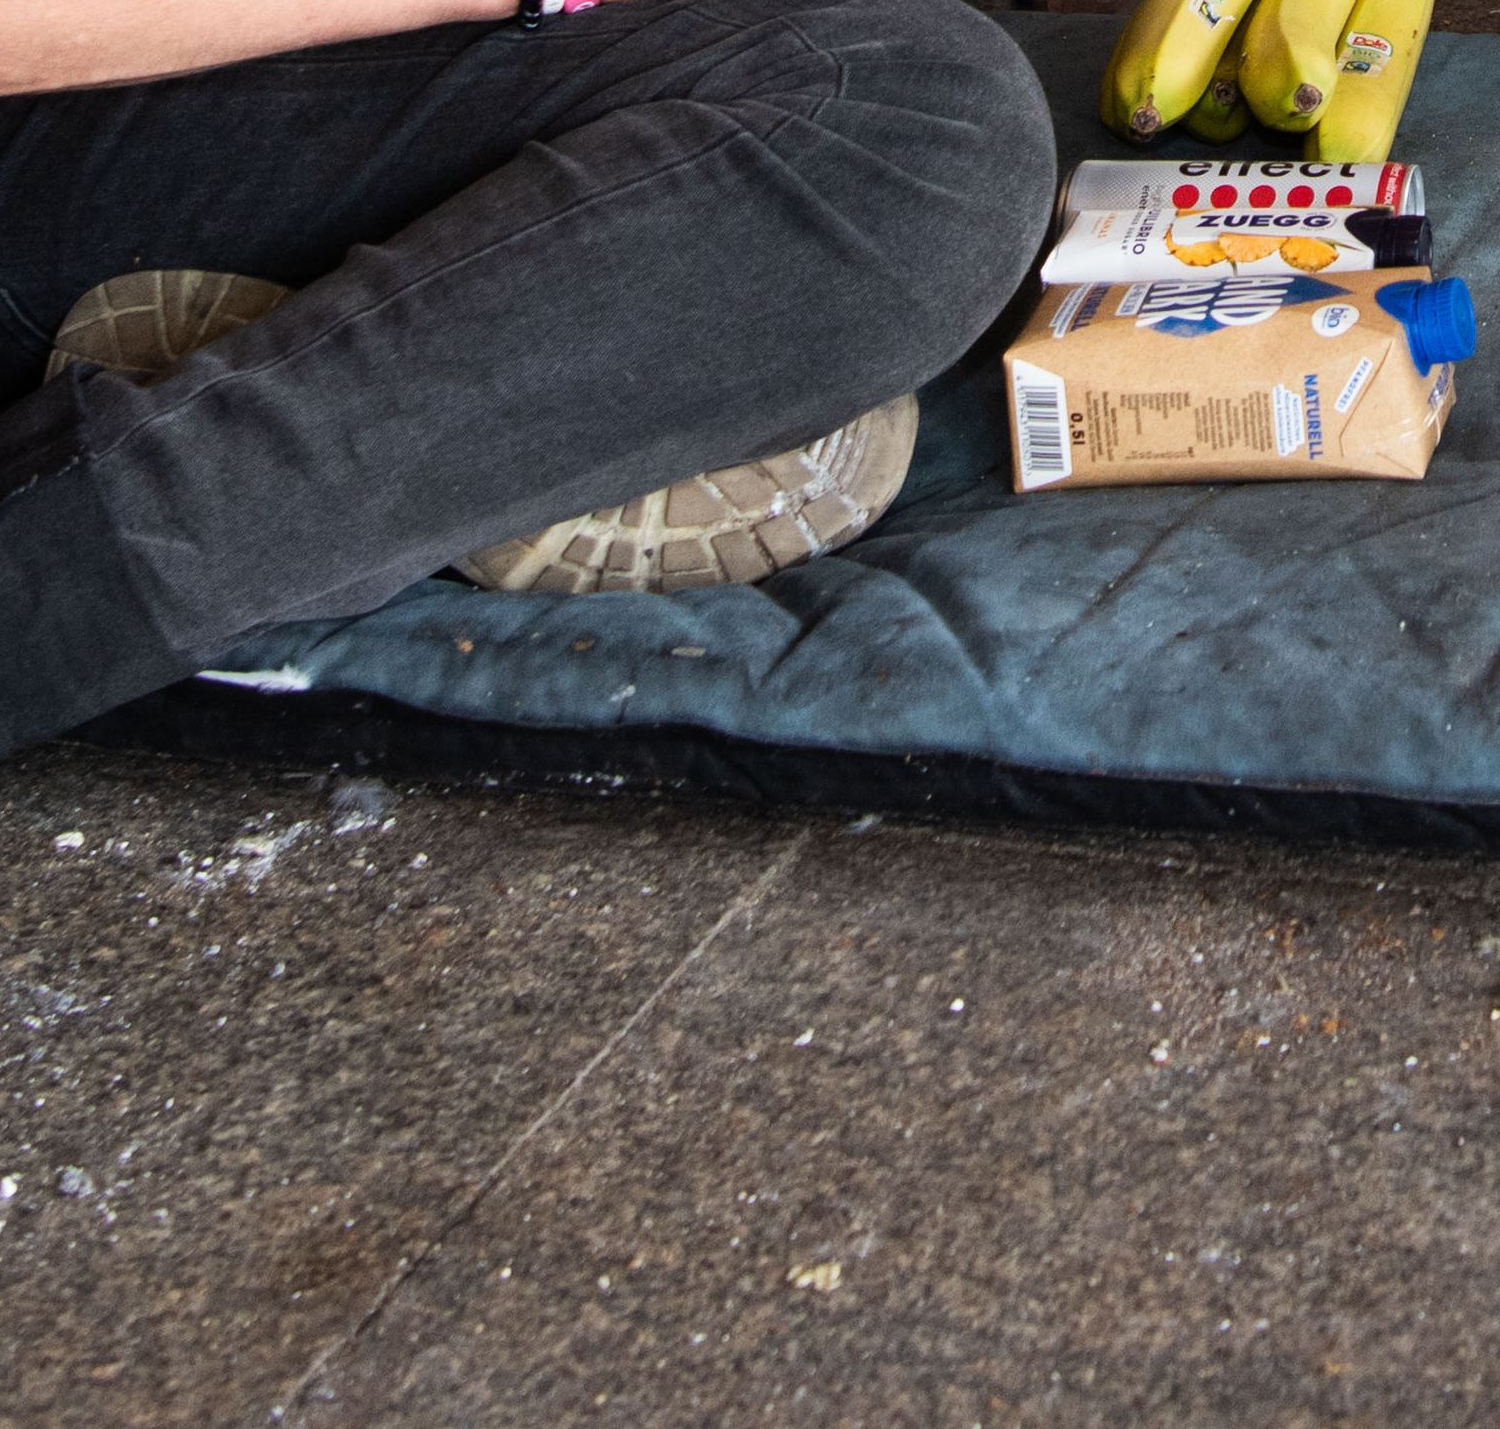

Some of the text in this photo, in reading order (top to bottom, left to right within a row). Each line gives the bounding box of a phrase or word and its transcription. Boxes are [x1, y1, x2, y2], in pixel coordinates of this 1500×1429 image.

[1196, 215, 1331, 228] ZUEGG
[1135, 280, 1222, 328] ARK
[1209, 277, 1296, 327] AND
[1304, 373, 1323, 460] NATURELL
